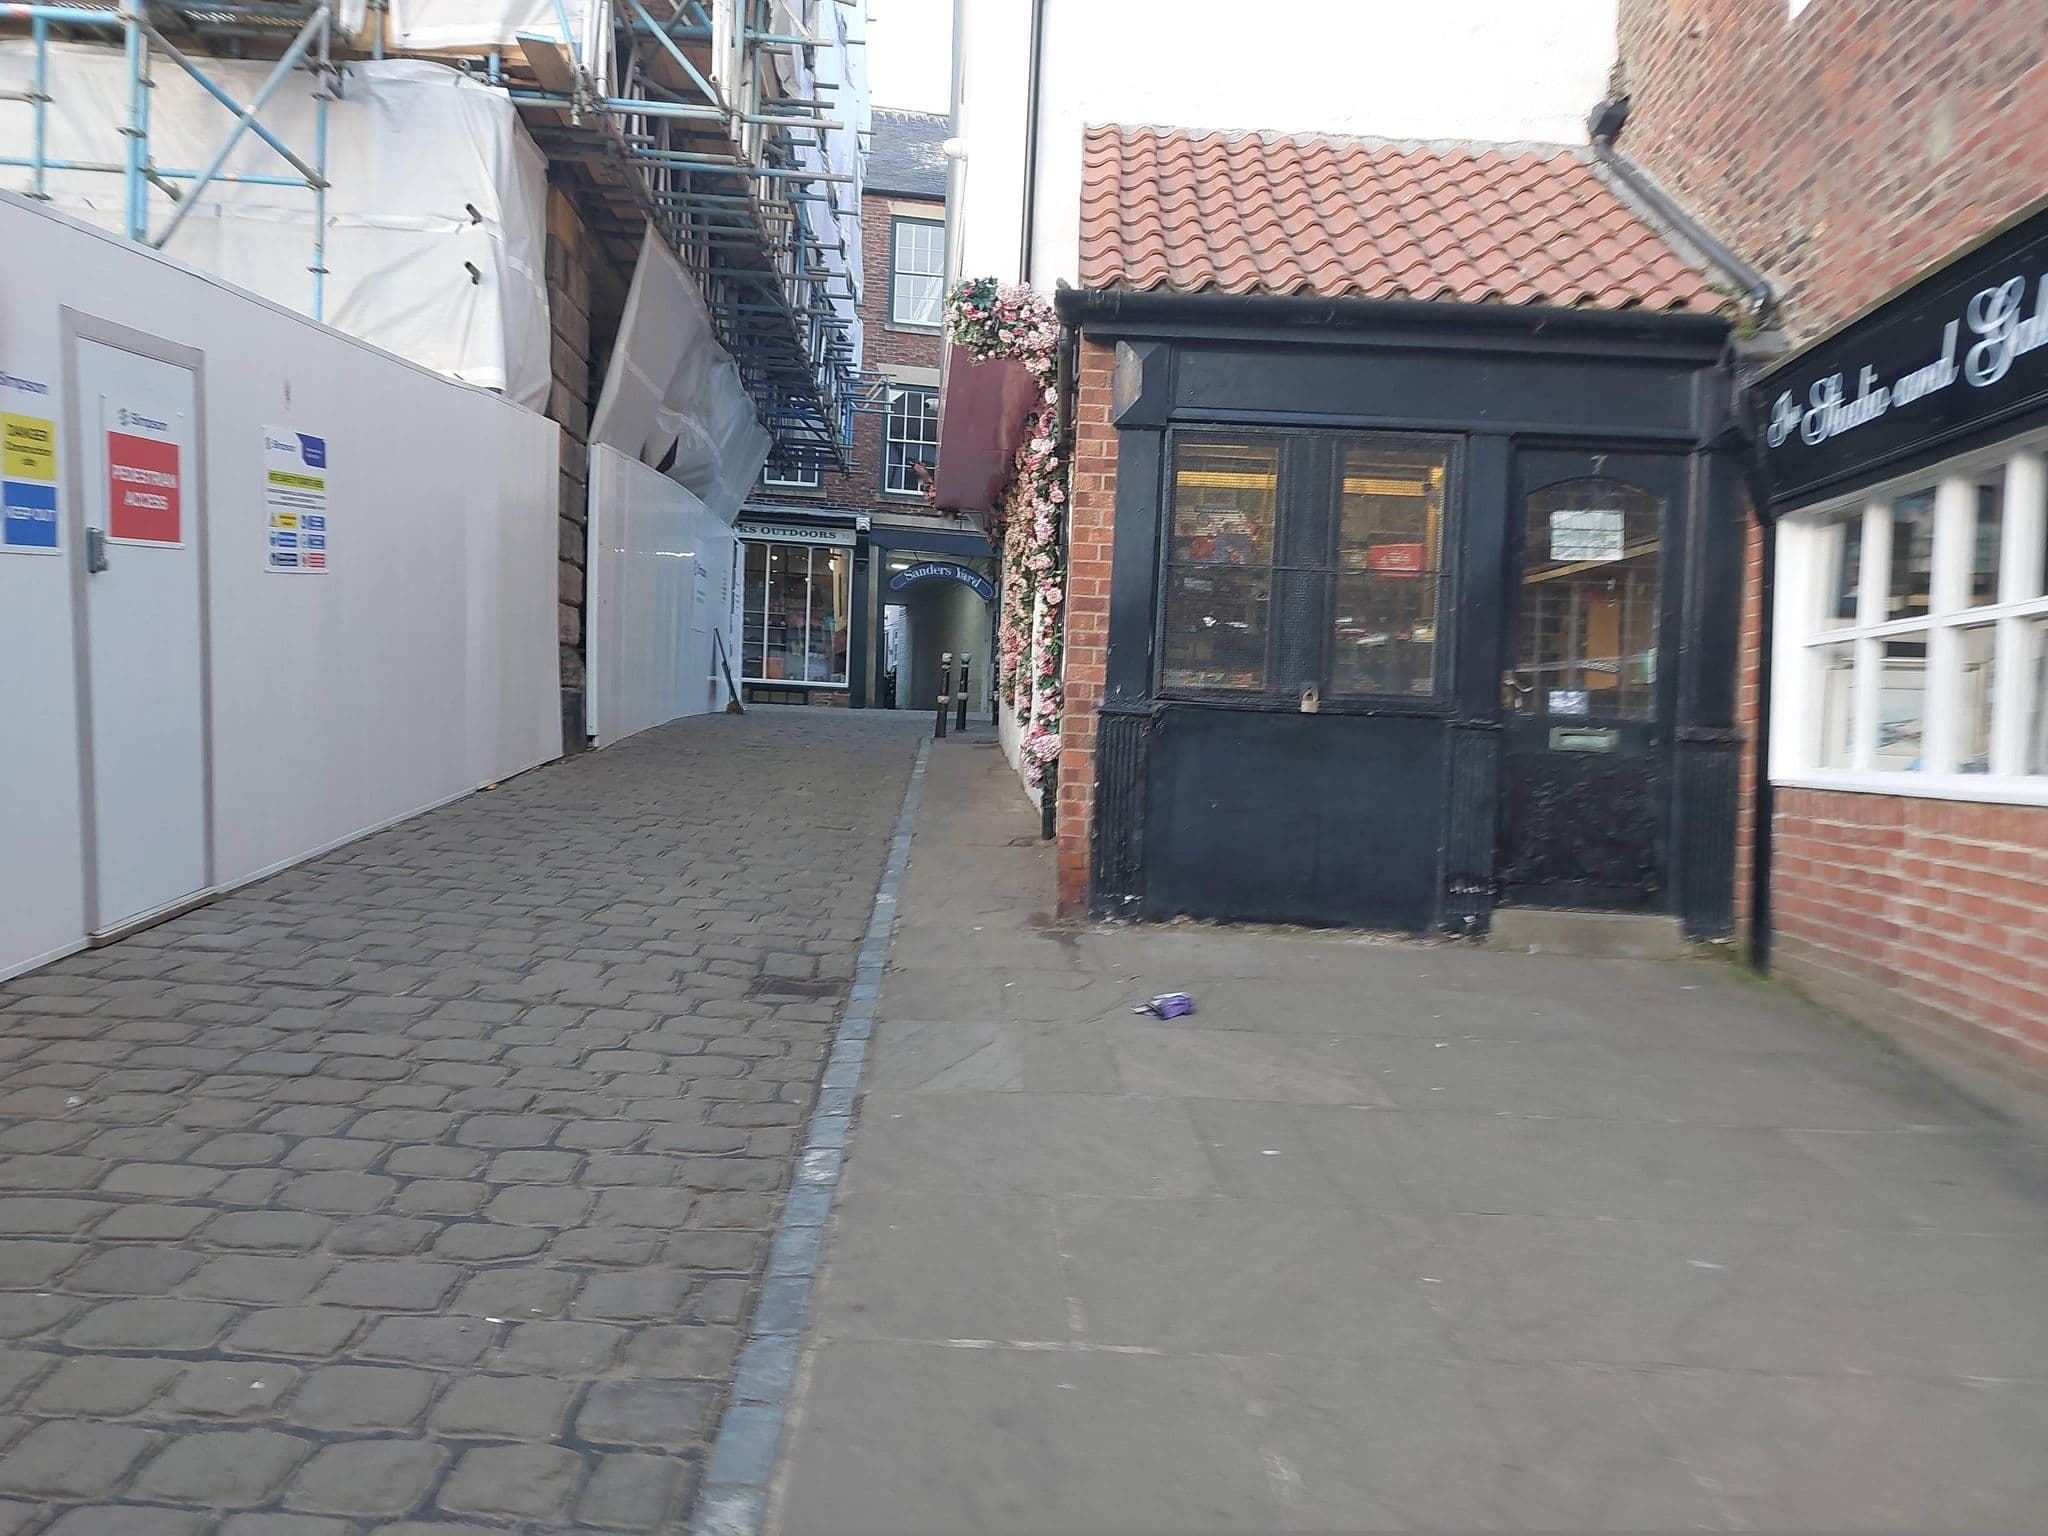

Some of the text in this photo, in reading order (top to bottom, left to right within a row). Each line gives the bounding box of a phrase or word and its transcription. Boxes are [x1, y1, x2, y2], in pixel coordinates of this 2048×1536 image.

[1890, 317, 1960, 408] and
[111, 463, 177, 489] PEDESTRIAN
[123, 490, 169, 511] ACCESS
[761, 526, 837, 540] OUTDOORS
[904, 564, 983, 588] Sanders Yard
